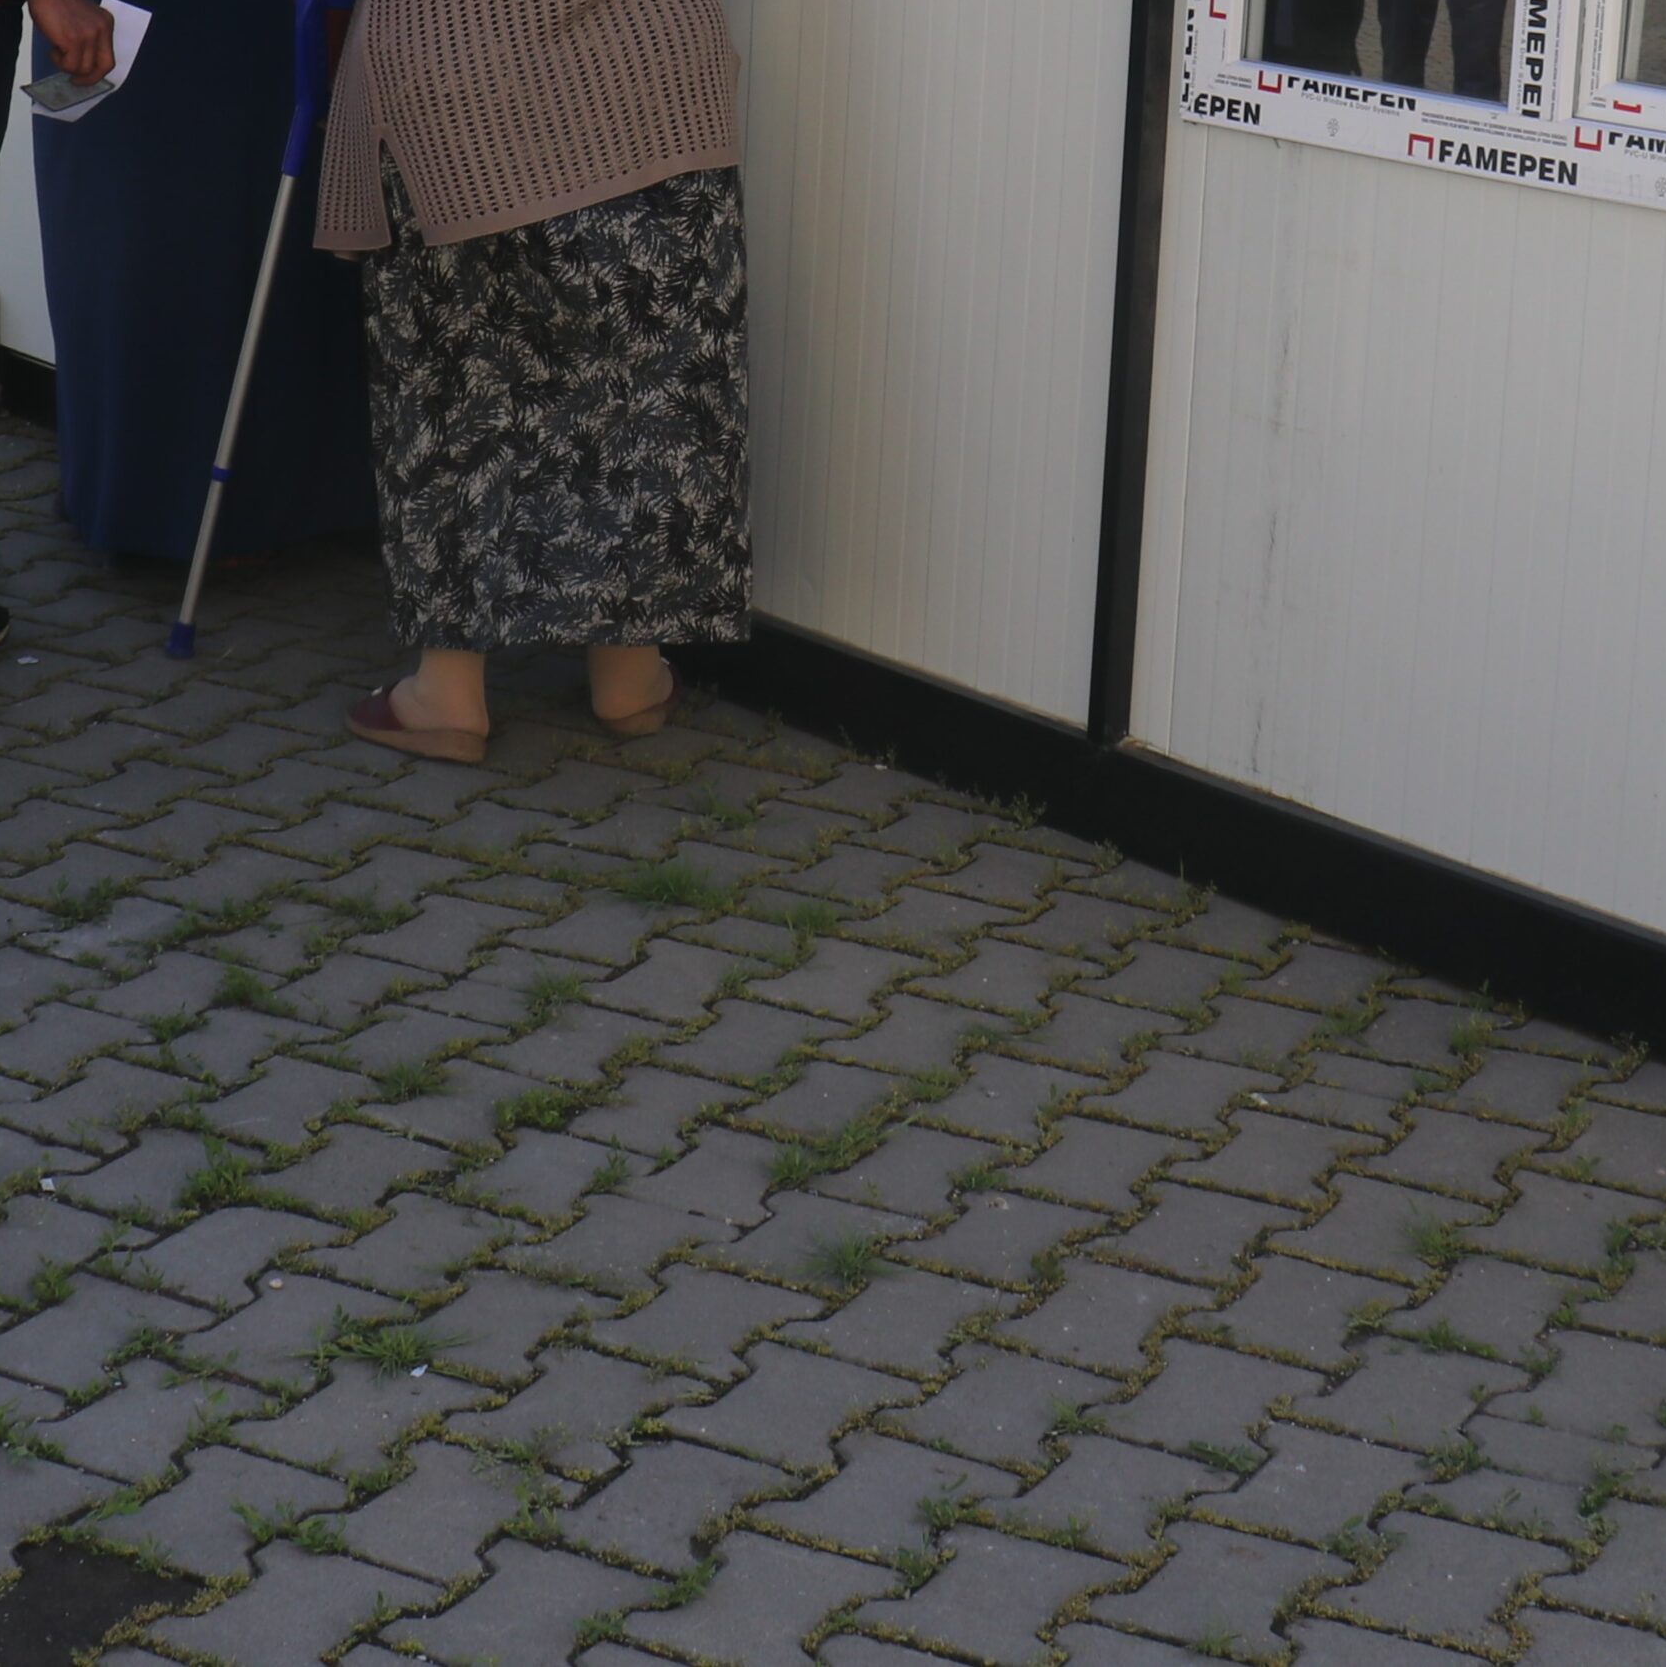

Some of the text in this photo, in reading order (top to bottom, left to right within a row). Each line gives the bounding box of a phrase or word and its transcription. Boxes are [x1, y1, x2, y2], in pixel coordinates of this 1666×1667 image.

[1520, 0, 1528, 36] Window
[1515, 72, 1523, 111] Systems
[1438, 139, 1578, 185] FAMEPEN
